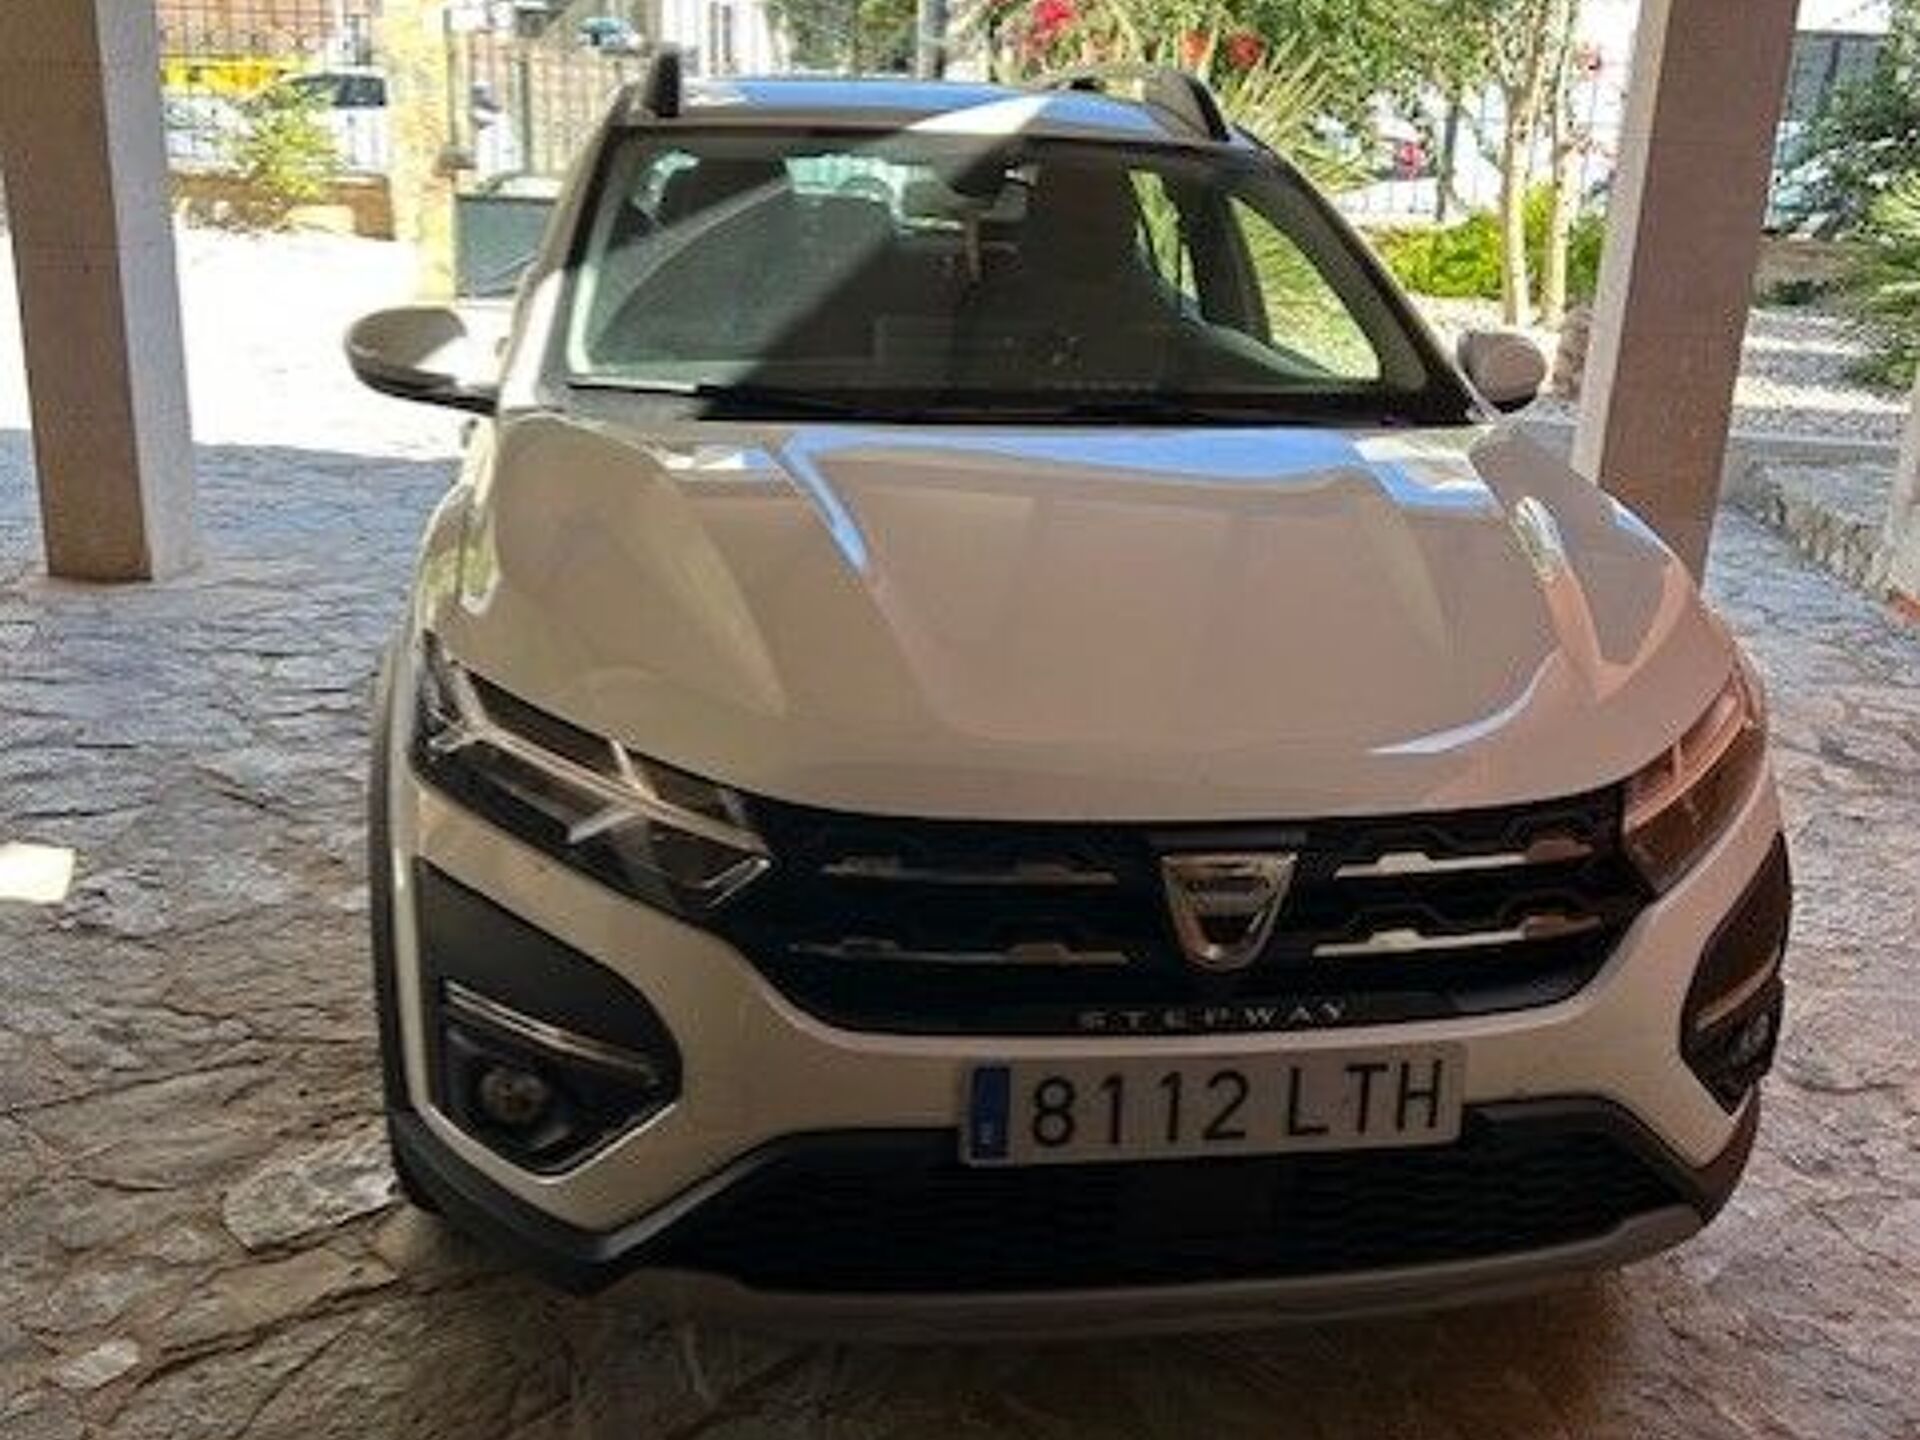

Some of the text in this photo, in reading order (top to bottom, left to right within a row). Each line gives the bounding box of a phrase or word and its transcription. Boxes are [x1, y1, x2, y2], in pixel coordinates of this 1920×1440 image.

[1079, 1002, 1346, 1030] STEPWAY
[1032, 1060, 1443, 1147] 8112 LTH
